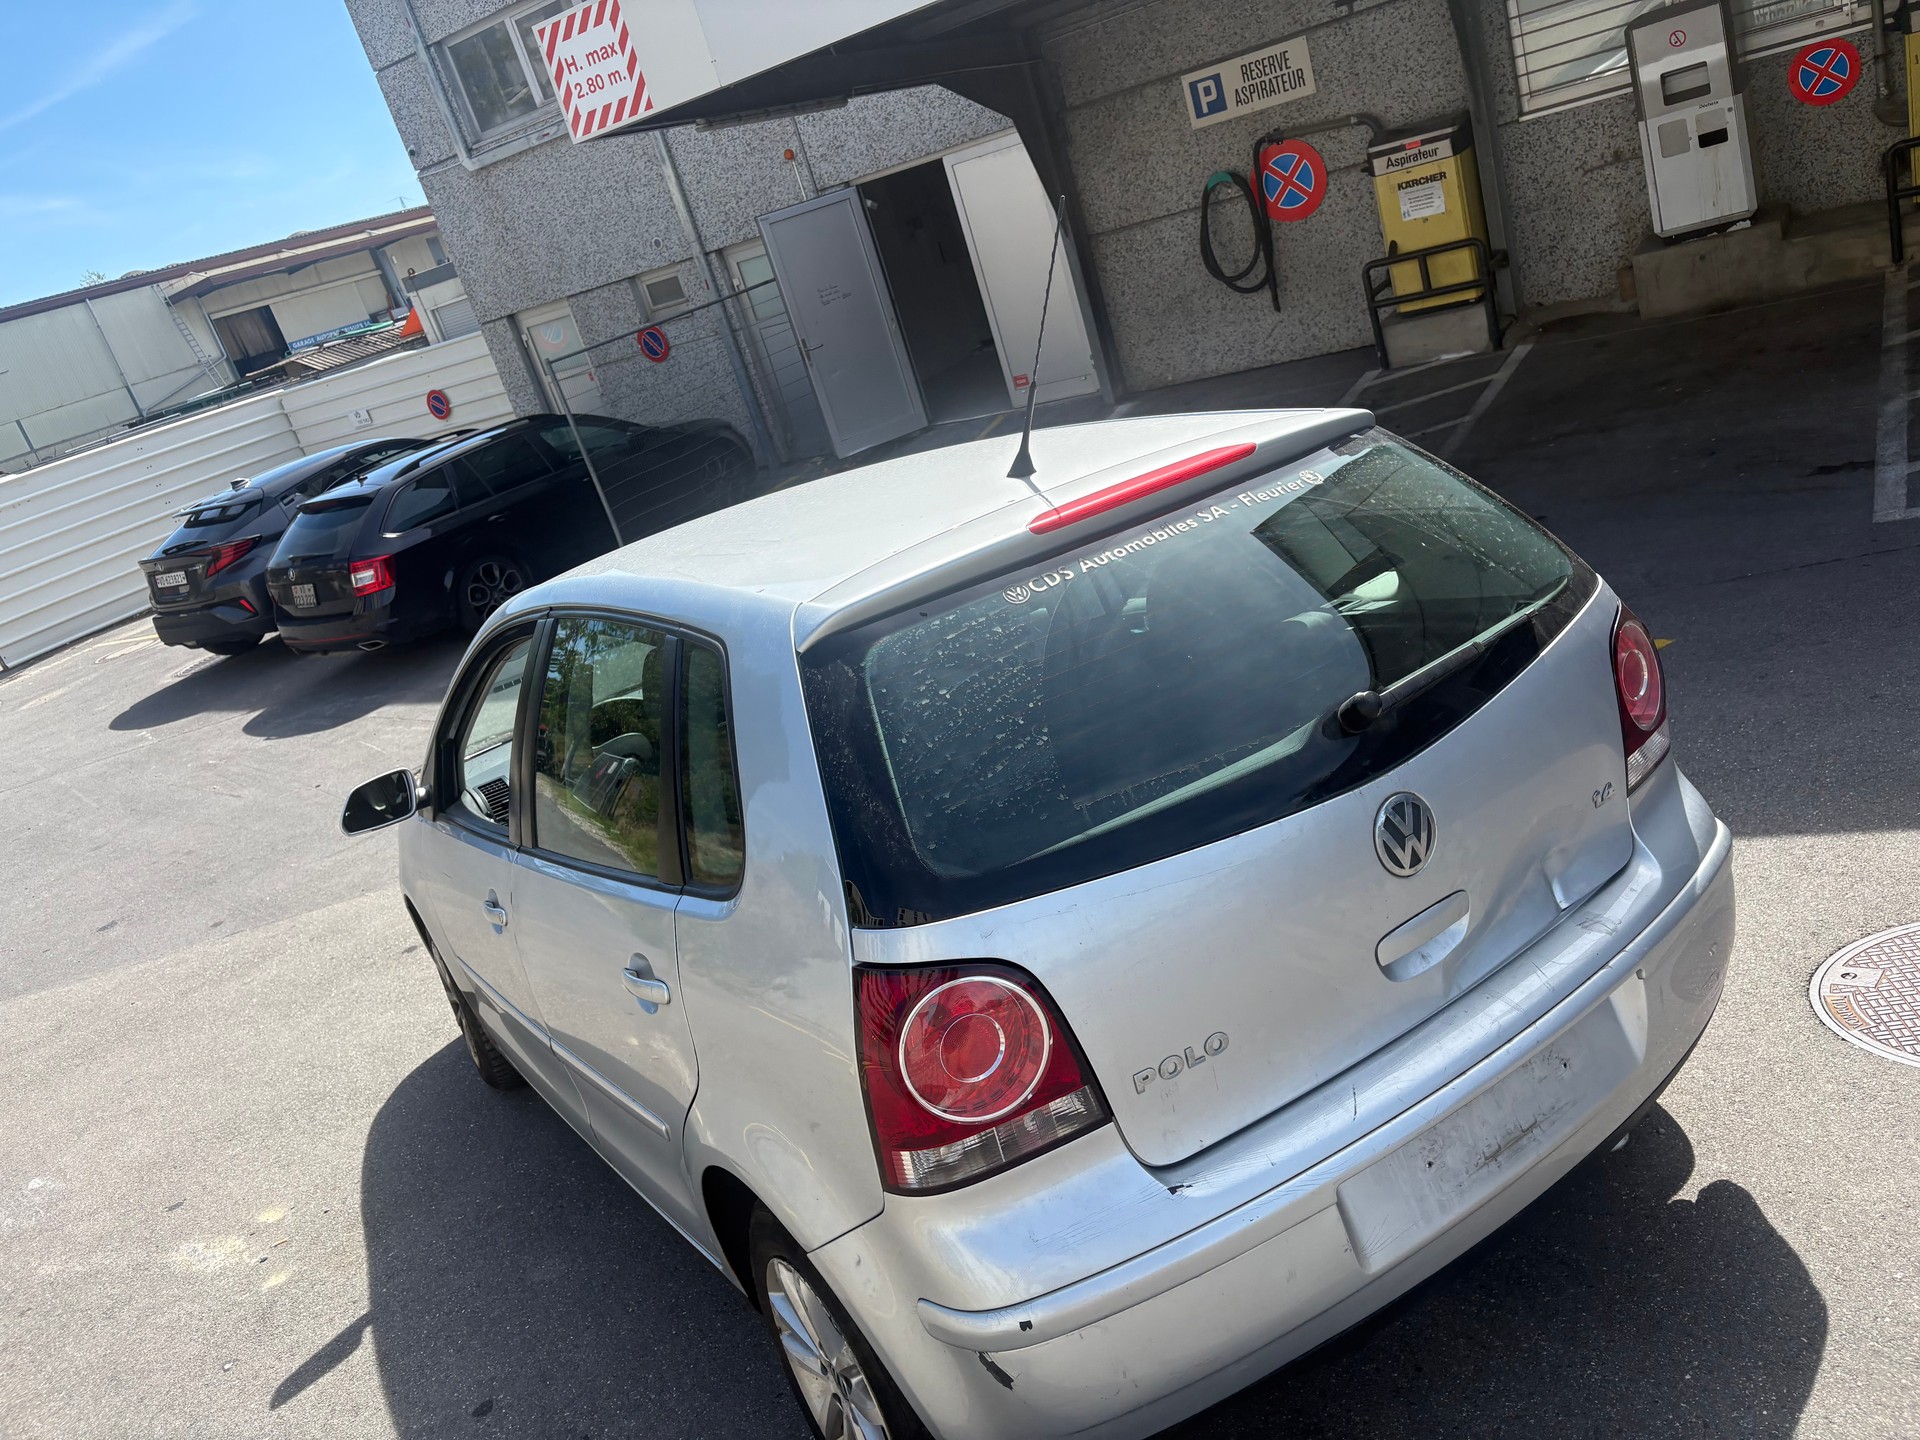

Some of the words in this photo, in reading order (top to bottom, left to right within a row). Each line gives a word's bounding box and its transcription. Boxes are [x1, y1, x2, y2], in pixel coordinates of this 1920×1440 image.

[564, 54, 583, 75] H.
[585, 42, 618, 67] max
[1240, 50, 1292, 83] RESERVE
[574, 73, 605, 99] 2.80
[608, 69, 627, 86] m.
[1196, 79, 1218, 114] P
[1234, 68, 1306, 107] ASPIRATEUR
[1386, 147, 1440, 170] Aspirateur
[1028, 565, 1075, 592] CDS
[1078, 517, 1199, 573] Automobiles
[1196, 505, 1229, 523] SA
[1237, 480, 1306, 507] Fleurier
[1132, 1031, 1229, 1095] POLO
